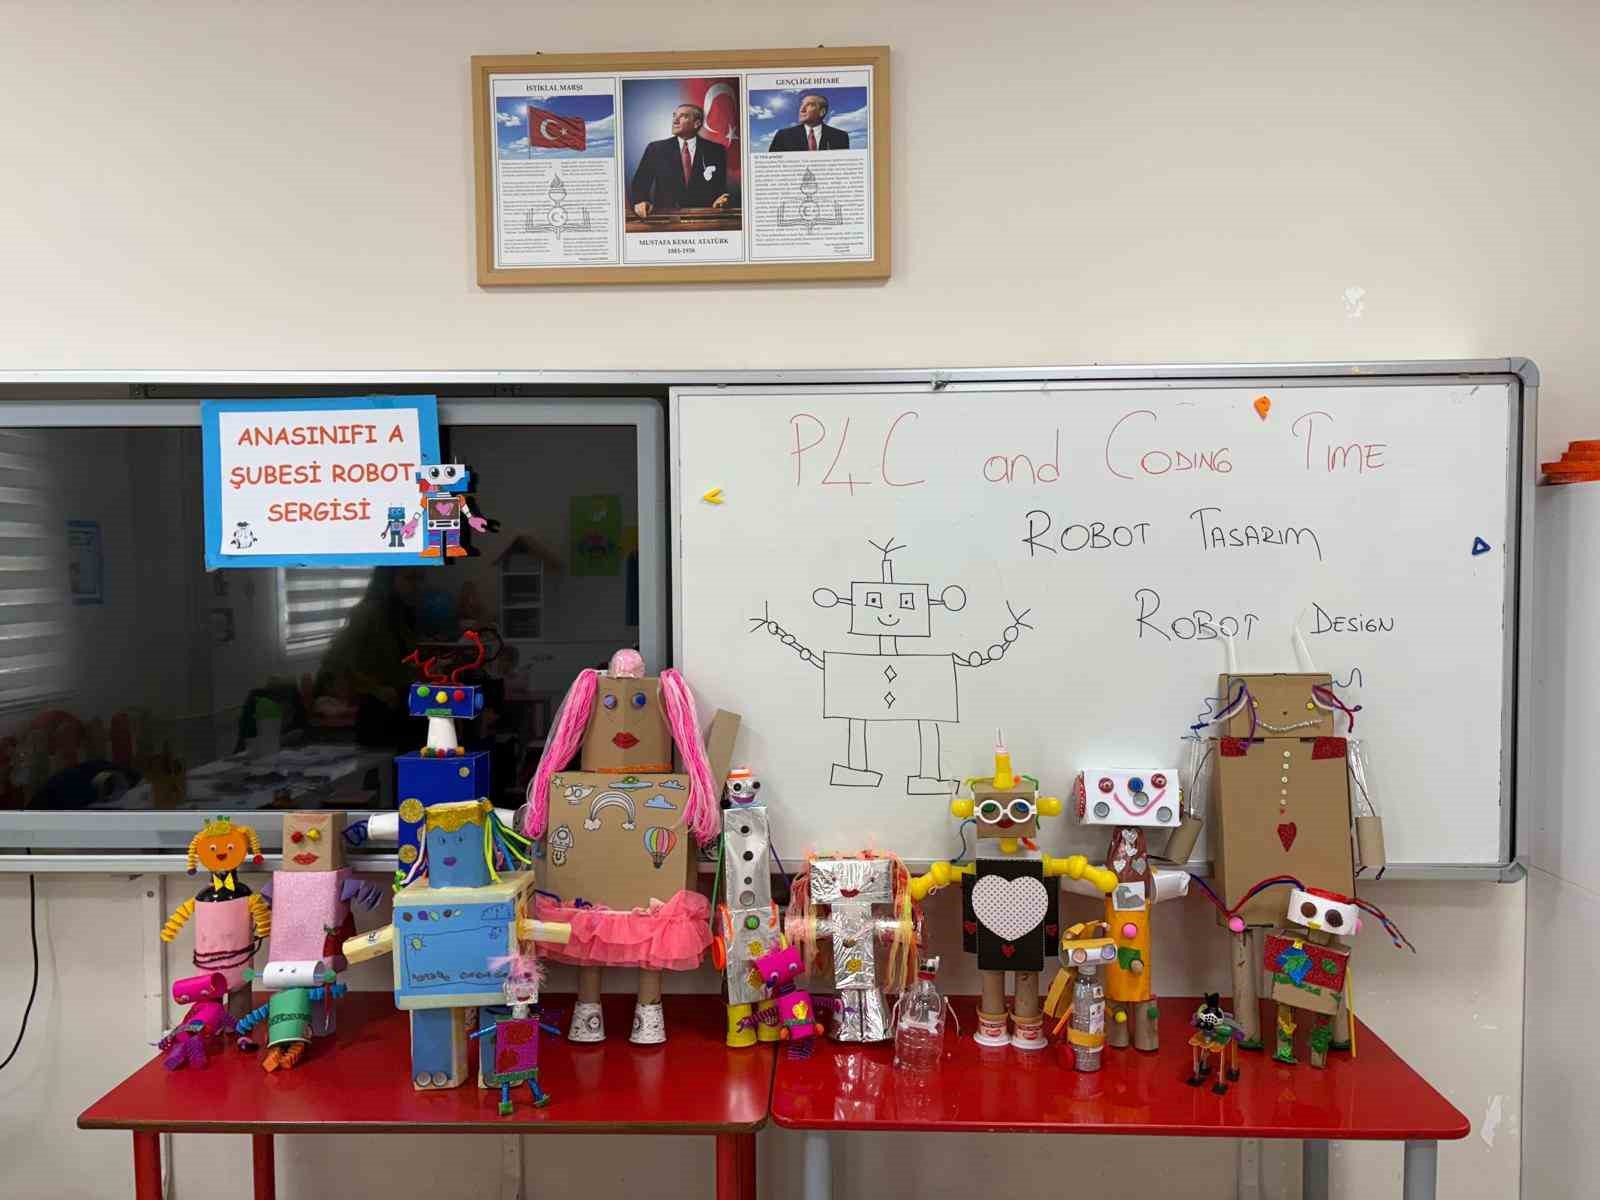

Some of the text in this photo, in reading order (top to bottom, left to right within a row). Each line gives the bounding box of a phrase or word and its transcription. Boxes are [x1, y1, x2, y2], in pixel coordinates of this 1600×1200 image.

[237, 424, 404, 446] ANASINIFI A
[983, 424, 1061, 485] and
[229, 461, 416, 490] ŞUBESİ ROBOT
[267, 498, 371, 523] SERGİSİ
[1021, 507, 1323, 562] ROBOT TASARIM
[1135, 588, 1260, 642] ROBOT
